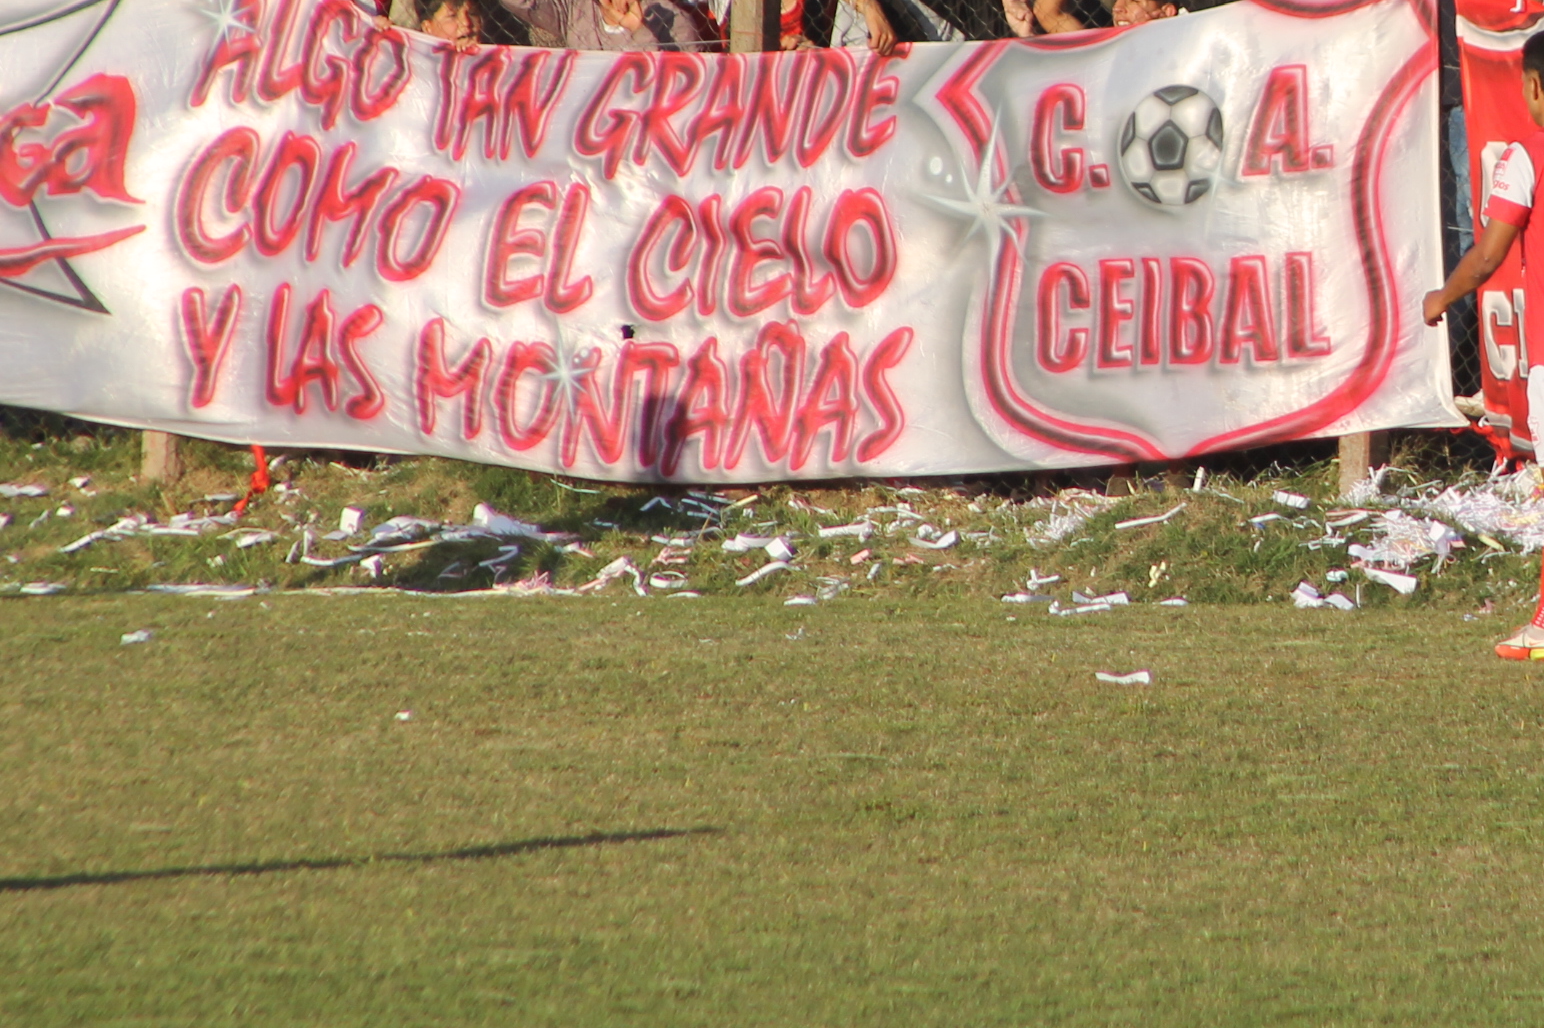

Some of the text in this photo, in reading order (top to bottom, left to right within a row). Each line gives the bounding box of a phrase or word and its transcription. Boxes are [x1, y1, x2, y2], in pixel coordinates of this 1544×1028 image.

[432, 43, 580, 162] TAN
[573, 41, 913, 179] GRANDE
[1241, 63, 1333, 177] A.
[176, 126, 898, 322] COMO EL CIELO
[181, 282, 914, 477] Y LAS MONTAÑAS
[1035, 251, 1331, 374] CEIBAL
